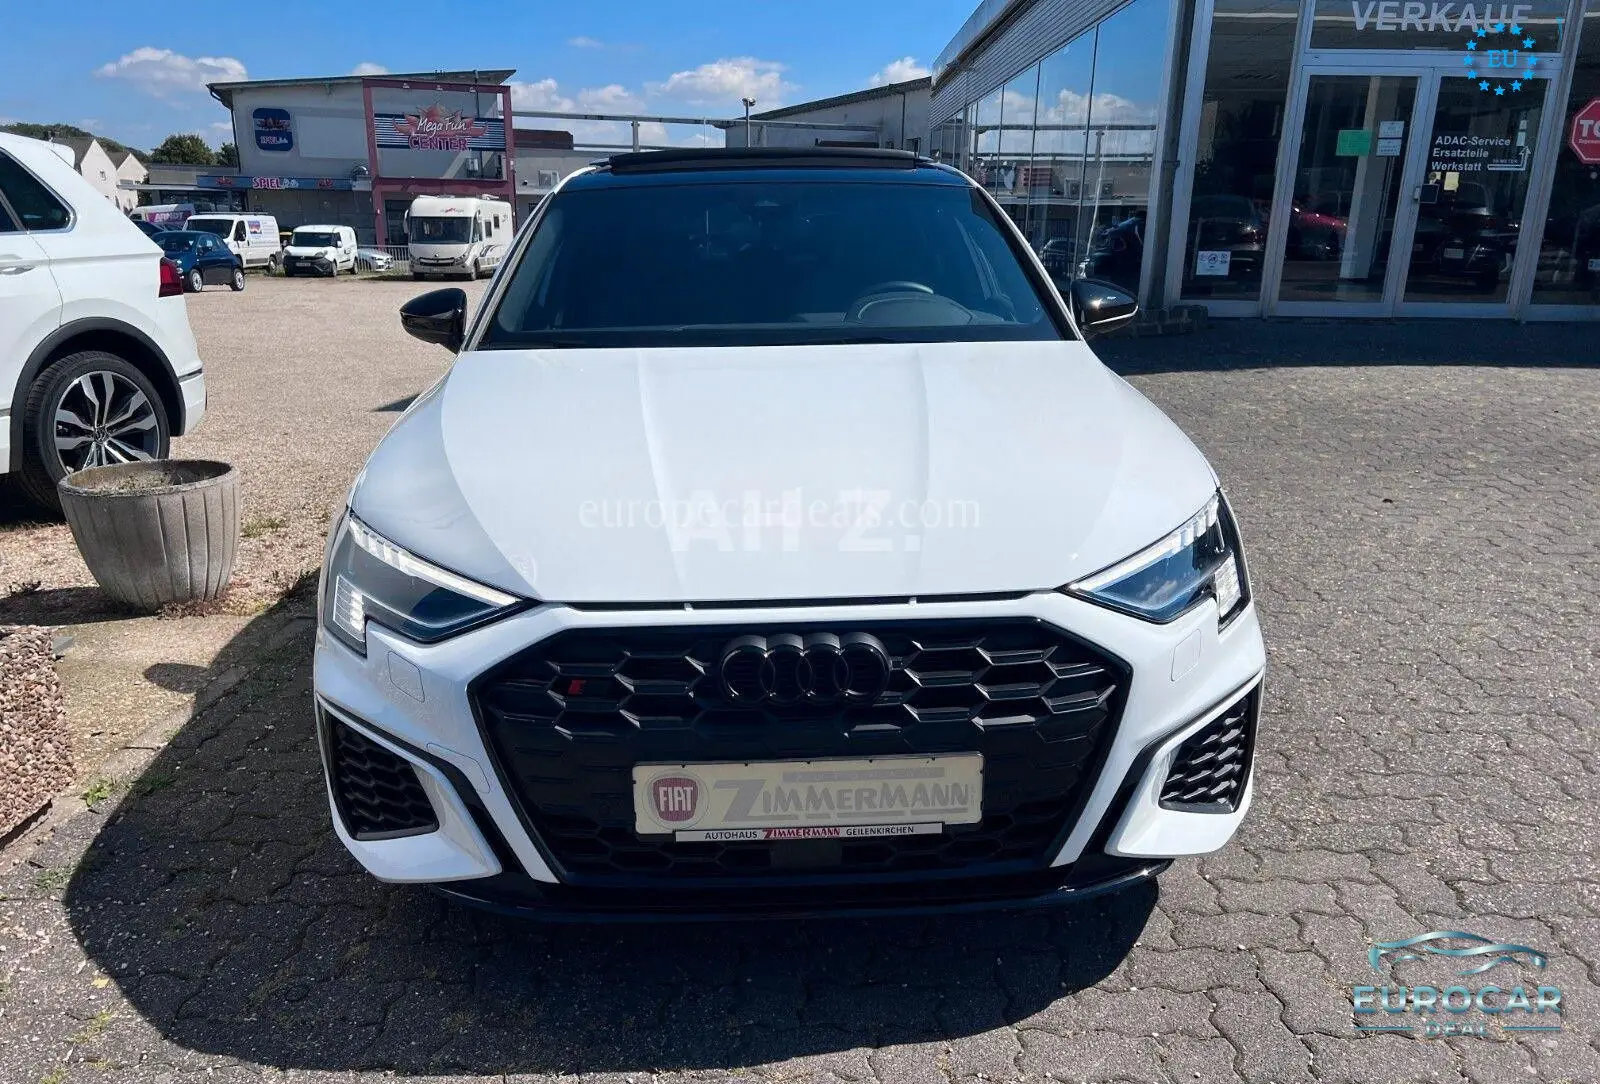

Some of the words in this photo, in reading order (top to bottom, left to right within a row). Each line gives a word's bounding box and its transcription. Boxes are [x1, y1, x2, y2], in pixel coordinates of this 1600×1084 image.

[1351, 0, 1533, 33] VERKAUF
[417, 116, 443, 138] Mega
[443, 116, 467, 132] Fun
[408, 135, 470, 151] CENTER
[1435, 136, 1511, 146] ADAC-Service
[1432, 148, 1489, 158] Ersatzteile
[1431, 161, 1482, 171] Werkstatt
[252, 177, 282, 189] SPIEL
[658, 786, 694, 812] FIAT
[713, 779, 969, 822] ZIMMERMANN
[704, 830, 758, 840] AUTOHAUS
[762, 827, 841, 840] ZIMMERMANN
[846, 825, 914, 836] GEILENKIRCHEN
